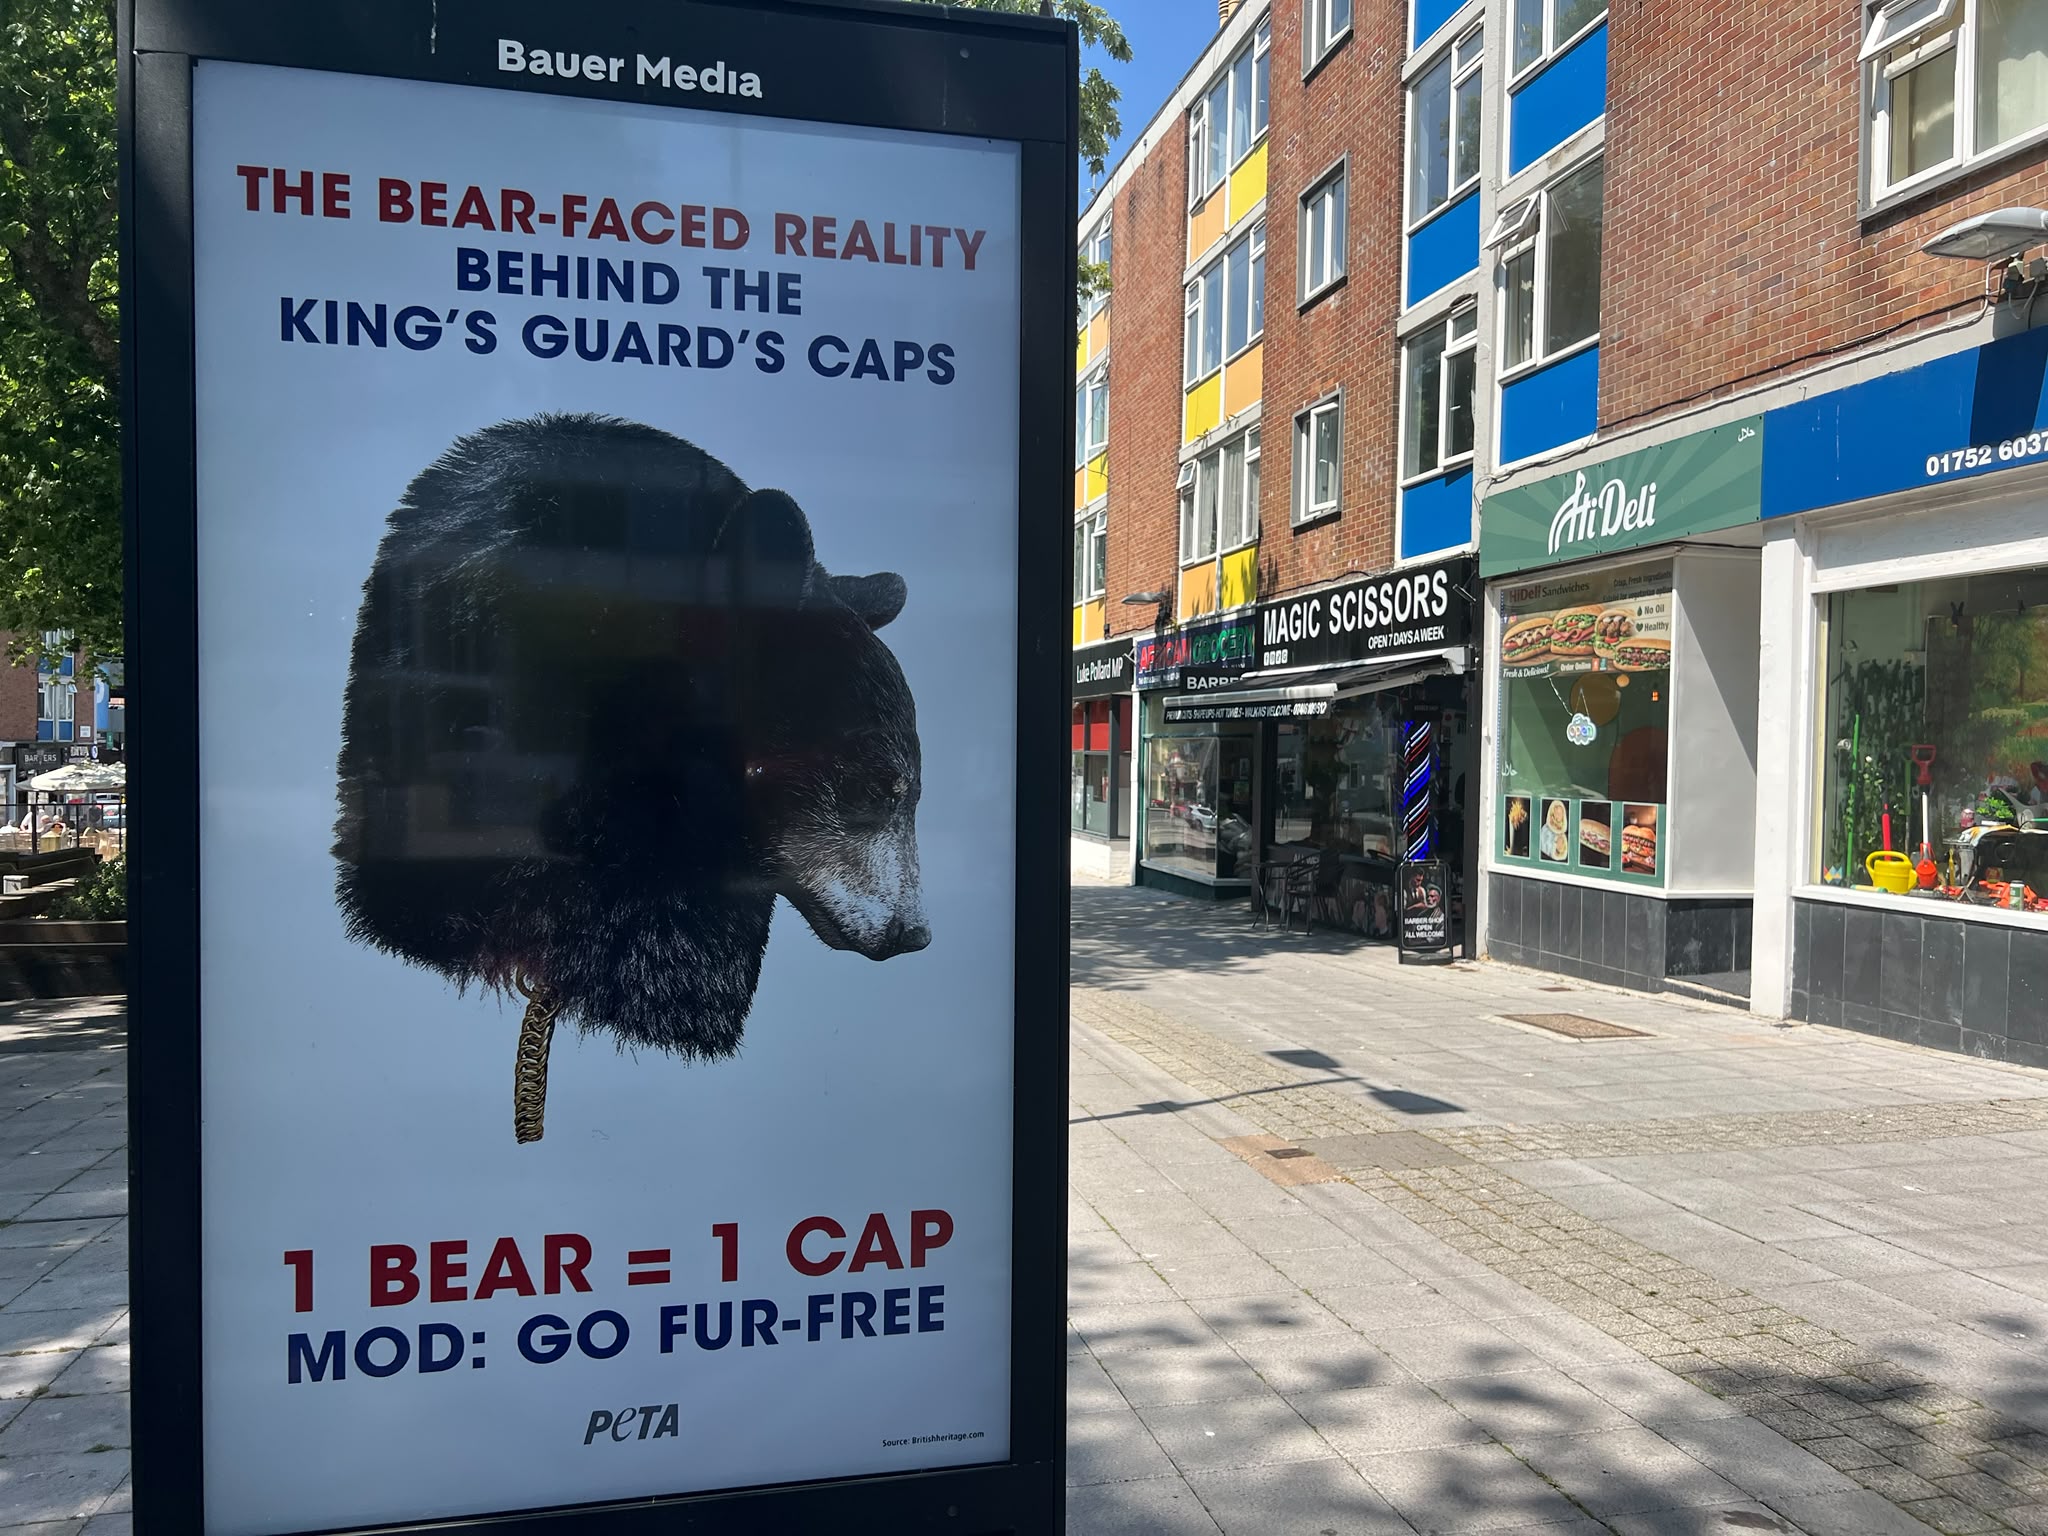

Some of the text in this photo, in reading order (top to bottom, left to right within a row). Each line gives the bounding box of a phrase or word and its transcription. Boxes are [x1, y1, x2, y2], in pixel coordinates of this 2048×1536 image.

[496, 38, 764, 100] Bauer Media
[236, 163, 988, 272] THE BEAR-FACED REALITY
[456, 246, 802, 316] BEHIND THE
[279, 296, 957, 386] KING’S GUARD’S CAPS
[1926, 444, 1992, 477] 01752
[1541, 580, 1591, 598] Sandwiches
[1628, 575, 1643, 586] Fresh
[1263, 568, 1448, 646] MAGIC SCISSORS
[1644, 604, 1665, 616] No Oil
[1368, 625, 1445, 650] OPEN 7 DAYS A WEEK
[1644, 622, 1669, 633] Healthy
[1138, 623, 1256, 674] AFRICAN GROCERY
[1076, 662, 1090, 684] Luke
[1090, 658, 1111, 681] Pollard
[1111, 656, 1124, 678] MP
[1503, 664, 1550, 678] Fresh & Delicious!
[1560, 661, 1591, 672] Order Online
[1266, 704, 1291, 717] WELCOME
[1569, 724, 1593, 738] open
[1404, 916, 1444, 925] BARBER SHOP
[1416, 930, 1445, 938] WELCOME
[283, 1208, 955, 1313] 1 BEAR = 1 CAP
[287, 1284, 947, 1385] MOD: GO FUR-FREE
[882, 1431, 985, 1448] Source: Britishheritage.com
